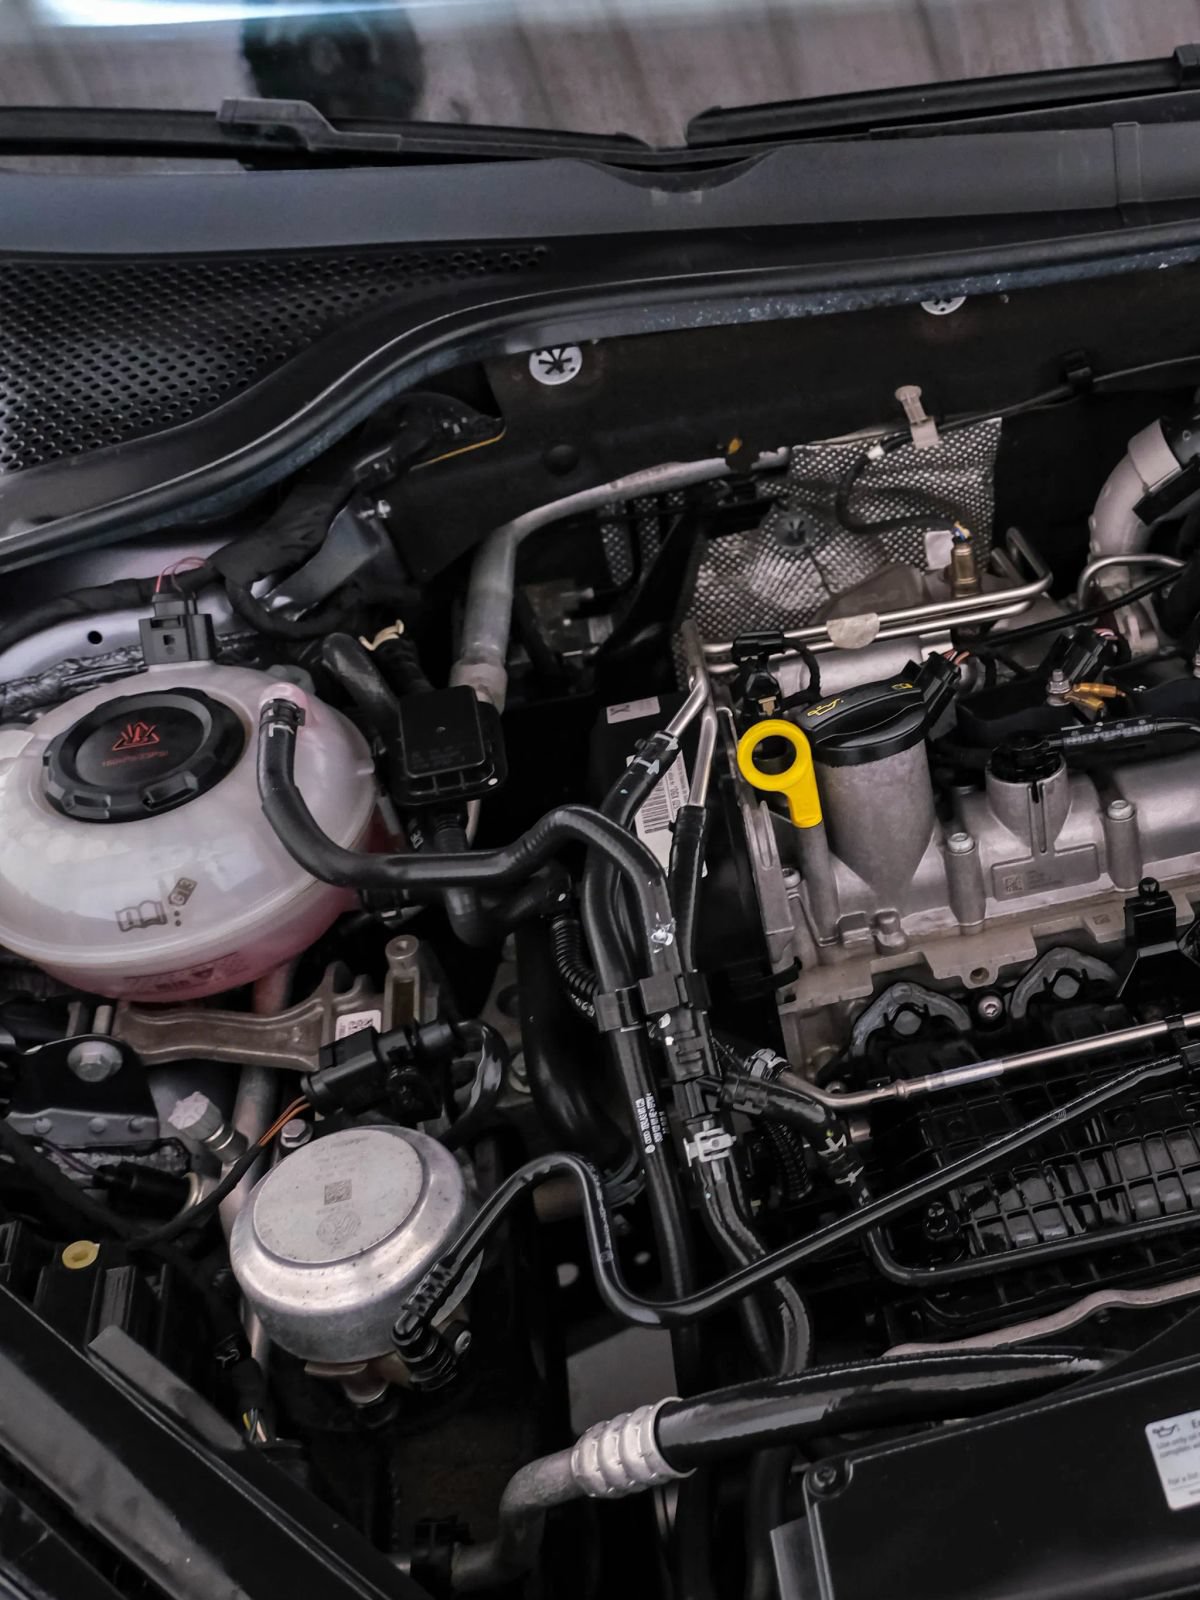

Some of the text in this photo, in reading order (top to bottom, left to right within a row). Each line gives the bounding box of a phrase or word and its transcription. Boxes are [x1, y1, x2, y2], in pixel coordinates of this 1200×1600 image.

[1156, 1441, 1170, 1449] Use
[1171, 1436, 1187, 1446] only
[1167, 1476, 1180, 1484] For
